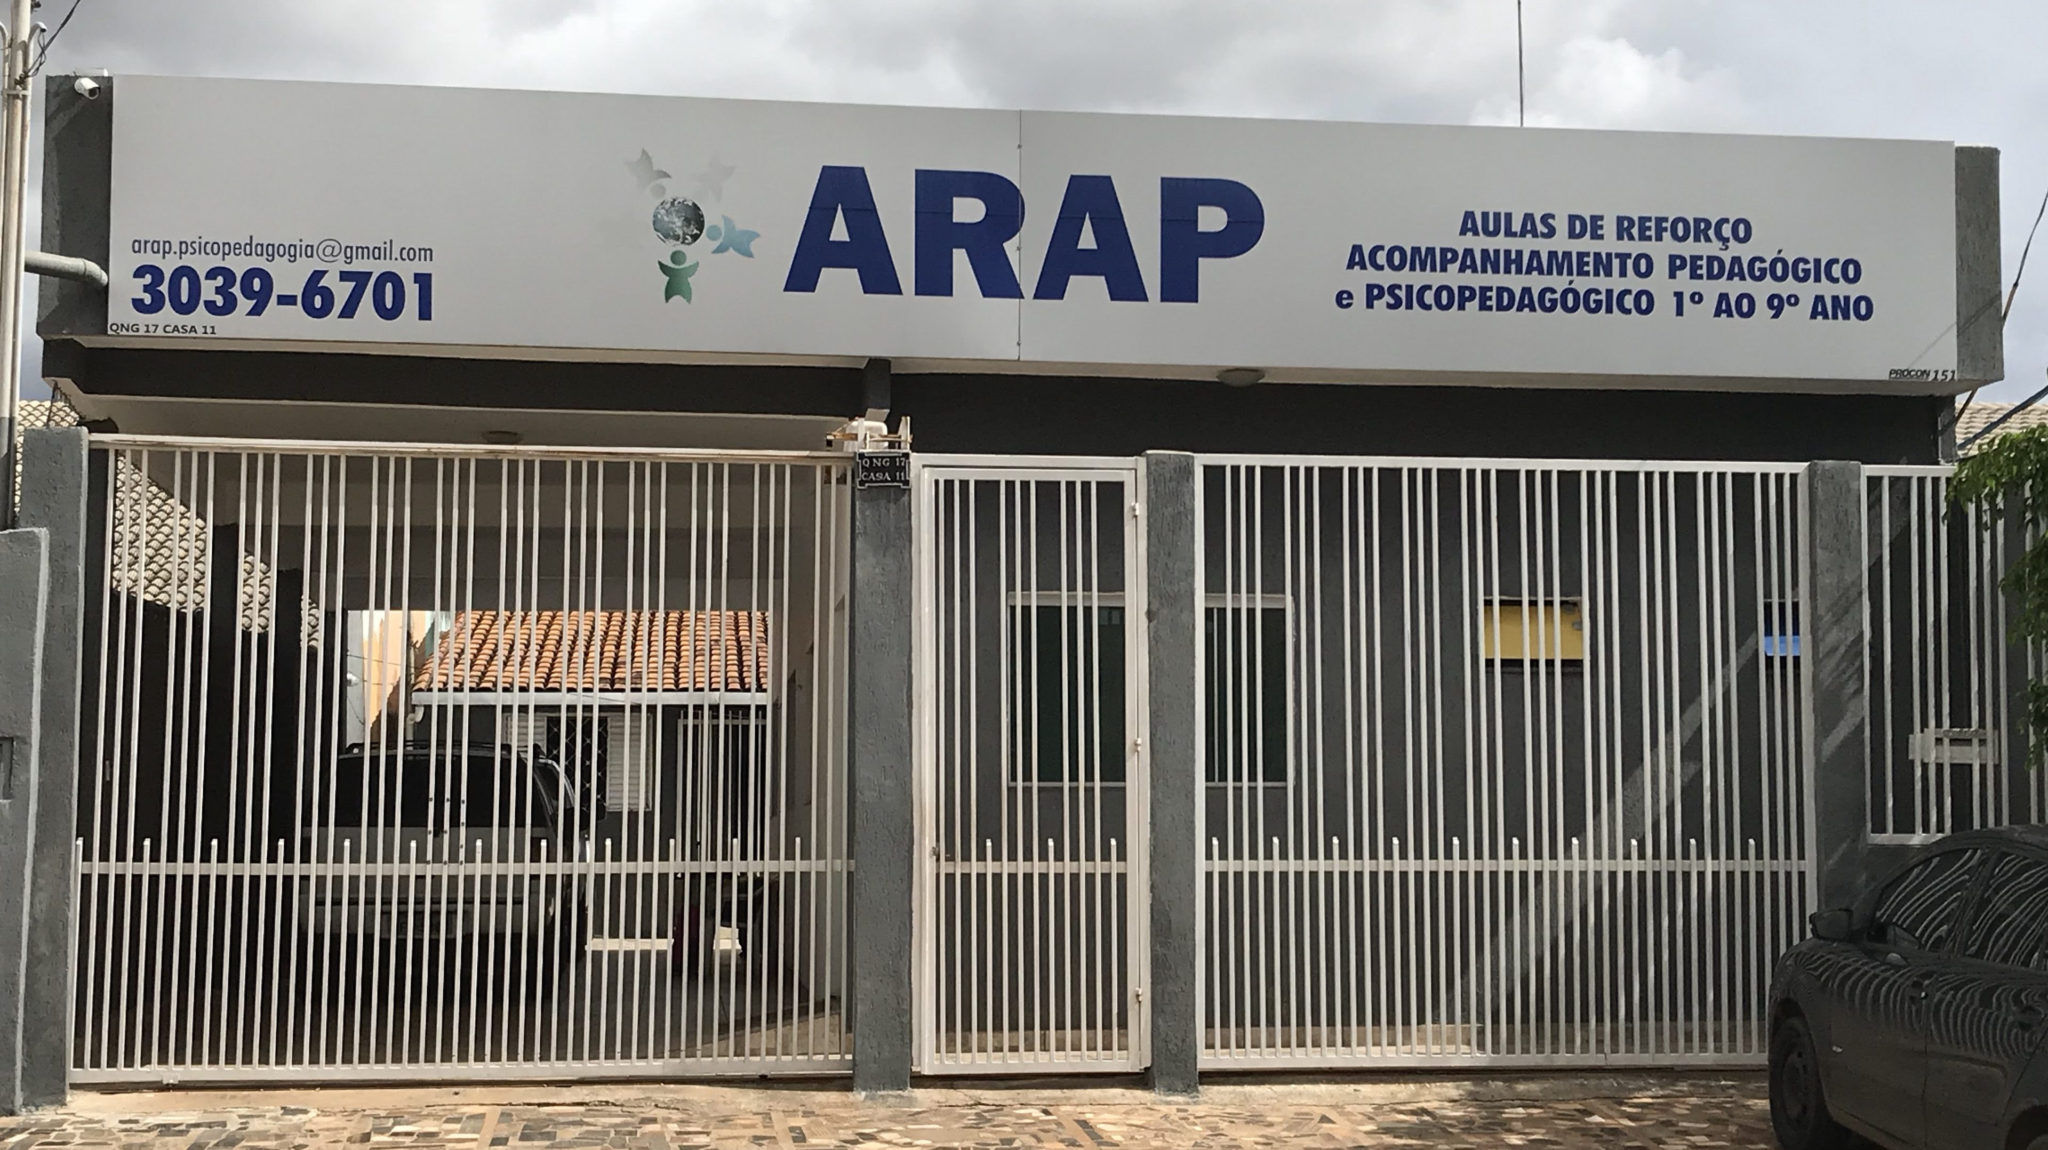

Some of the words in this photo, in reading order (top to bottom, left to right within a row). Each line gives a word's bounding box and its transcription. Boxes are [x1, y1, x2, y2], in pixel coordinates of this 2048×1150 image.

[783, 166, 1265, 303] ARAP
[1459, 211, 1556, 239] AULAS
[1568, 214, 1605, 241] DE
[1616, 216, 1753, 251] REFORÇO
[132, 235, 434, 265] arap.psicopedagogia@gmail.com
[1346, 244, 1654, 279] ACOMPANHAMENTO
[1669, 249, 1862, 285] PEDAGÓGICO
[131, 265, 433, 321] 3039-6701
[1335, 290, 1354, 310] e
[1366, 280, 1655, 316] PSICOPEDAGÓGICO
[1713, 293, 1756, 319] AO
[1810, 295, 1874, 321] ANO
[109, 323, 140, 335] QNG
[144, 324, 159, 334] 17
[163, 325, 198, 335] CASA
[202, 325, 217, 335] 11
[1888, 369, 1930, 379] PROCON
[1932, 370, 1956, 381] 151
[861, 472, 891, 481] CASA
[895, 472, 905, 481] 11
[862, 458, 890, 468] QNG
[895, 457, 906, 467] 17
